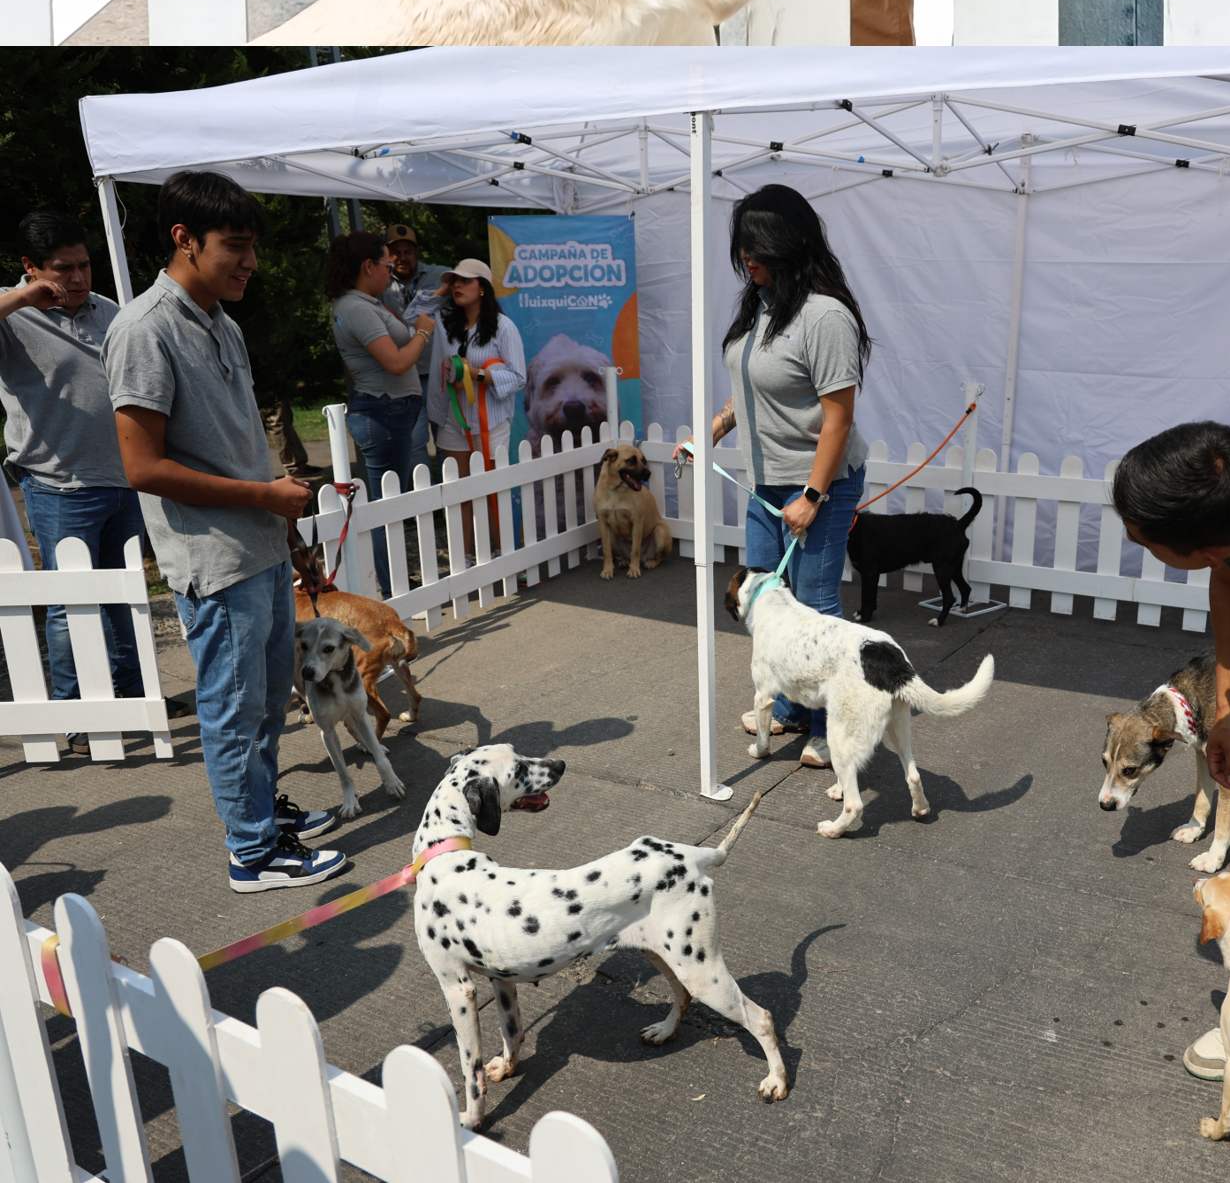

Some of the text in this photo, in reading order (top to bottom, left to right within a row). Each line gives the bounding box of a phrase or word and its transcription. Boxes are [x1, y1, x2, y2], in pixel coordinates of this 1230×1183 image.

[518, 245, 608, 261] CAMPAÑA DE
[507, 259, 623, 284] ADOPCIÓN
